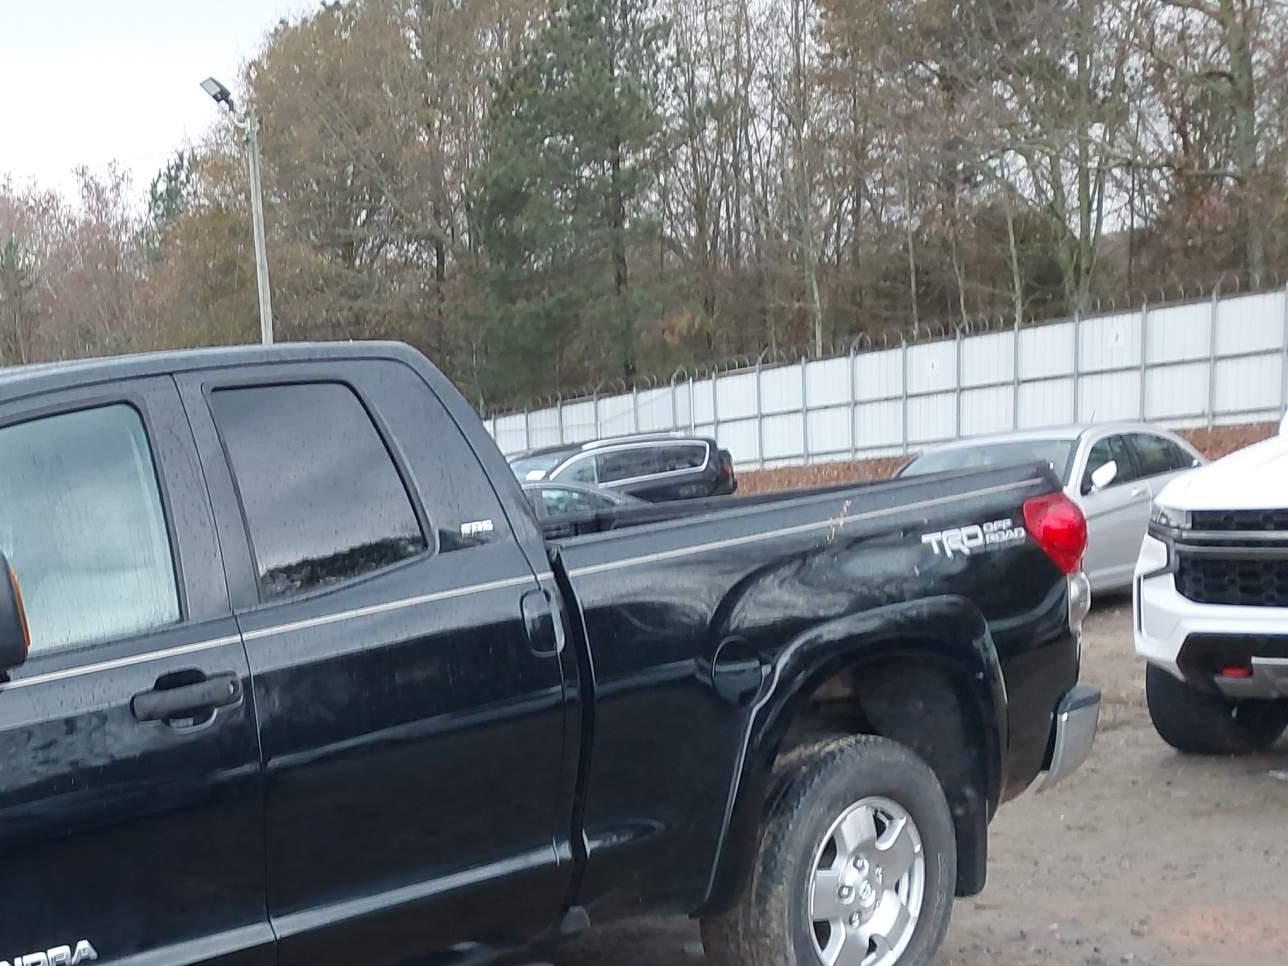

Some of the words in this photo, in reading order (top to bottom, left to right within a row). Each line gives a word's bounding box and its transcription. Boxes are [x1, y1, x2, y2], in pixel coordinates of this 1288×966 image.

[983, 518, 1013, 533] OFF
[921, 524, 984, 560] TRD
[985, 527, 1027, 545] ROAD
